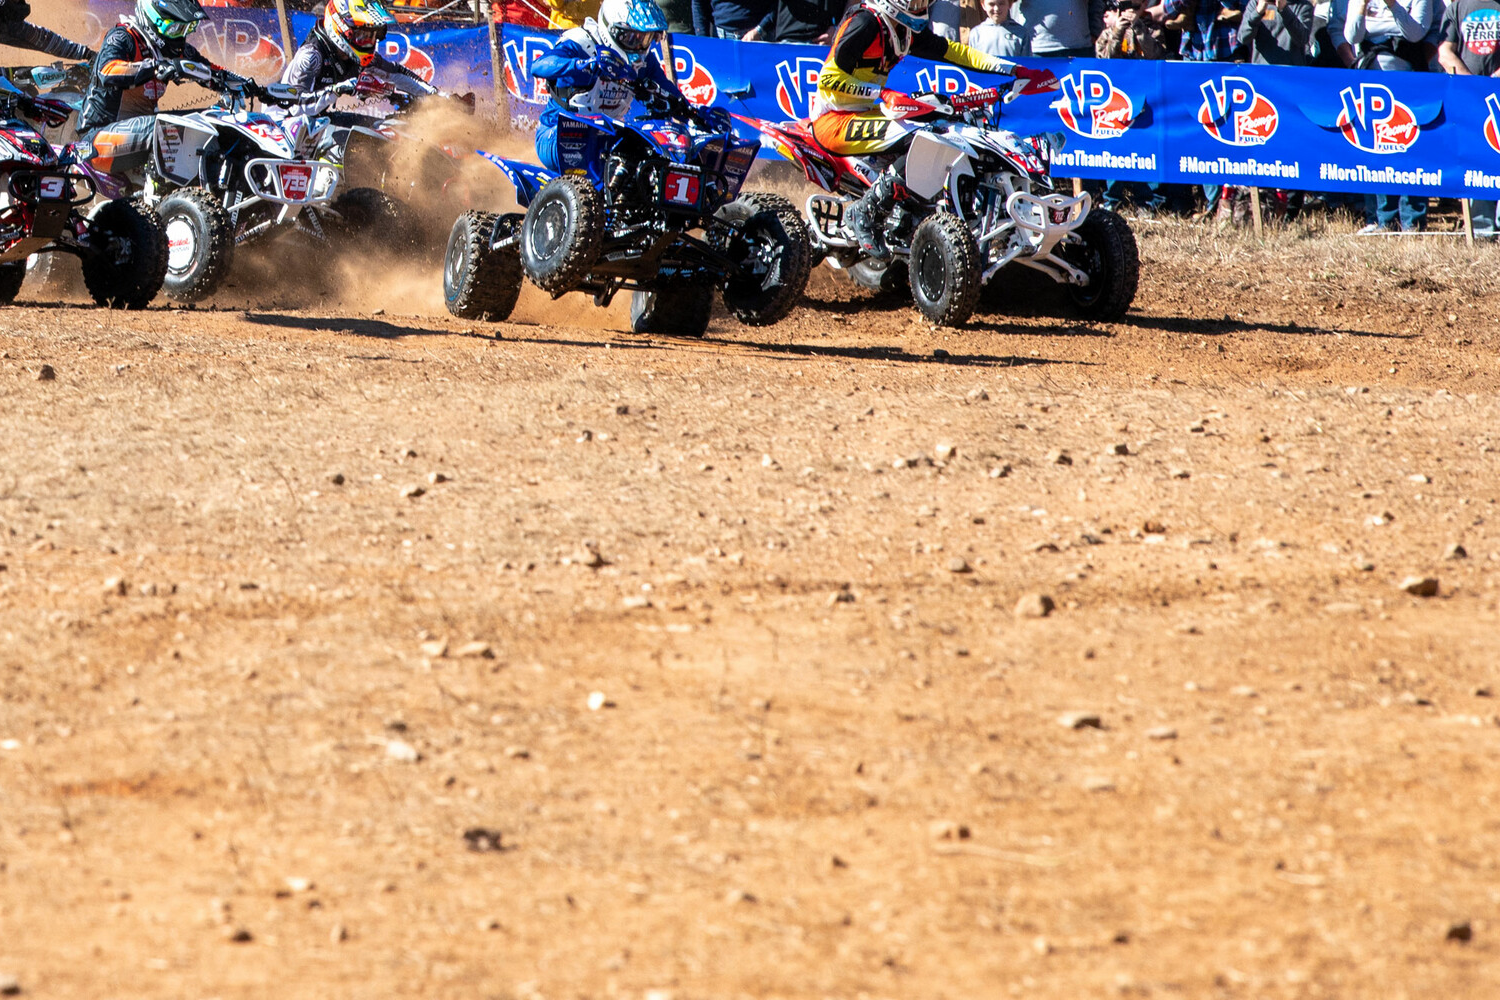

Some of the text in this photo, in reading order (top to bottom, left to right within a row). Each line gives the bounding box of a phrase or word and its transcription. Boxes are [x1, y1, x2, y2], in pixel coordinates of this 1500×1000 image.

[831, 79, 872, 97] RACING
[955, 92, 996, 104] RENTHAL
[1059, 69, 1114, 137] VP
[1199, 75, 1257, 144] VP
[562, 120, 589, 129] YAMAHA
[1239, 114, 1276, 134] Racing
[1339, 82, 1395, 151] VP
[850, 120, 886, 139] FLY
[1095, 128, 1122, 136] FUELS
[1239, 135, 1266, 144] FUELS
[1376, 121, 1414, 142] Racing
[1377, 143, 1406, 152] FUELS
[1179, 155, 1300, 179] #MoreThanRaceFuel
[1319, 162, 1443, 187] #MoreThanRaceFuel
[44, 176, 66, 199] 3
[282, 174, 309, 192] 733
[673, 177, 690, 202] 1
